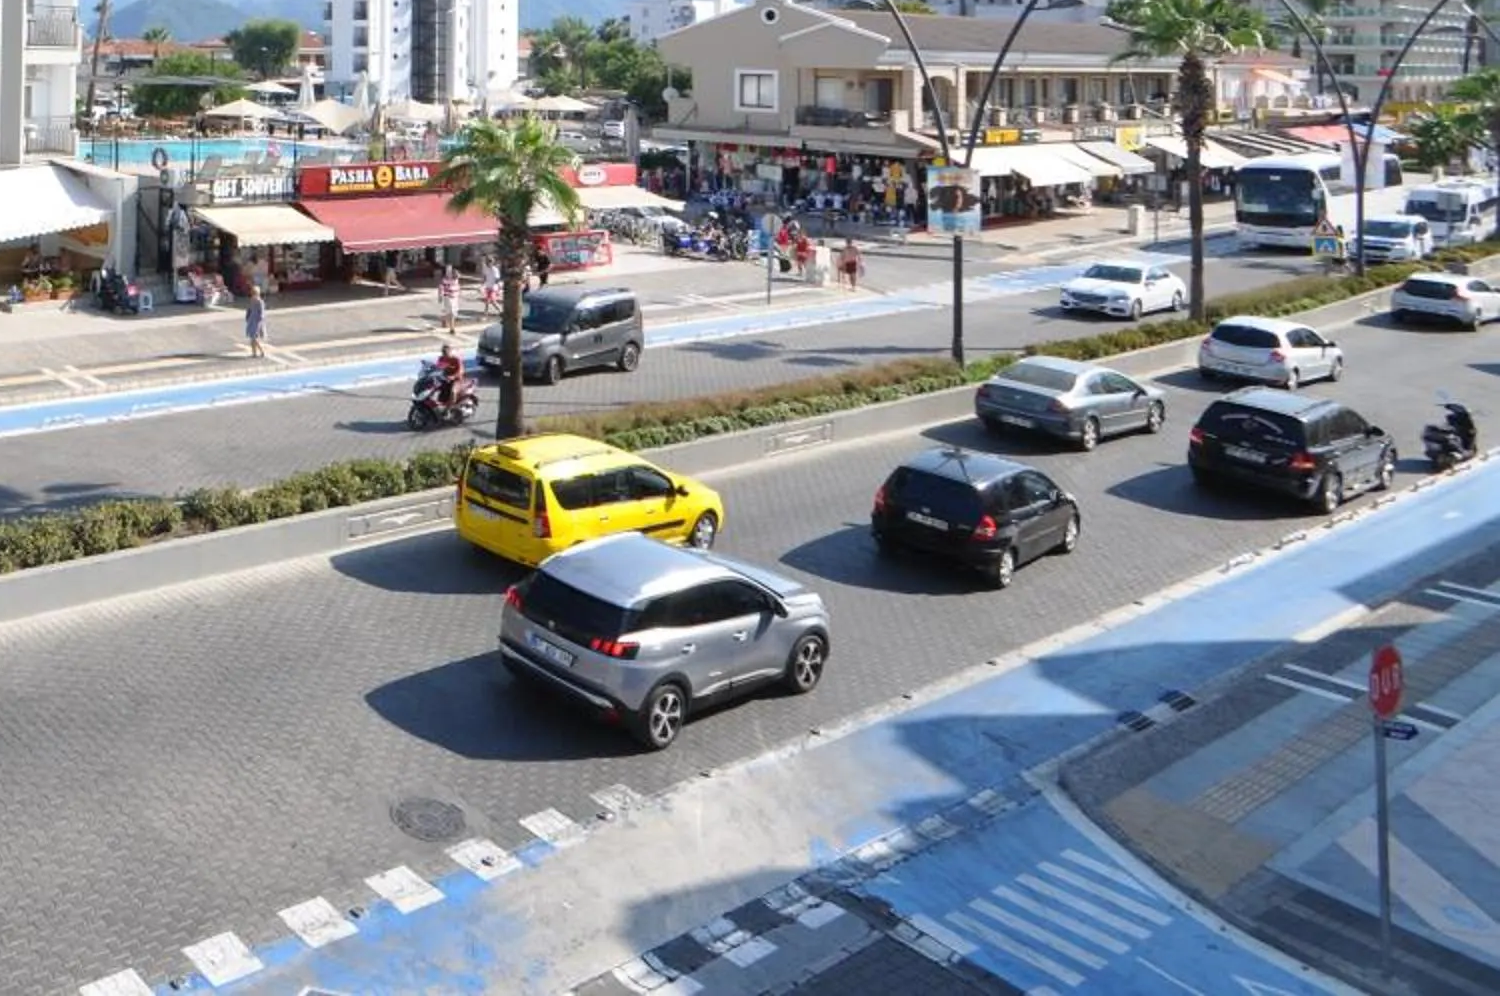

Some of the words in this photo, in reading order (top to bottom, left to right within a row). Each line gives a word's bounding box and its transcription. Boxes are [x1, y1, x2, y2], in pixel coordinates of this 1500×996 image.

[330, 168, 373, 185] PASHA
[393, 165, 429, 180] BABA
[213, 179, 237, 197] GIFT
[1371, 664, 1399, 701] DUR
